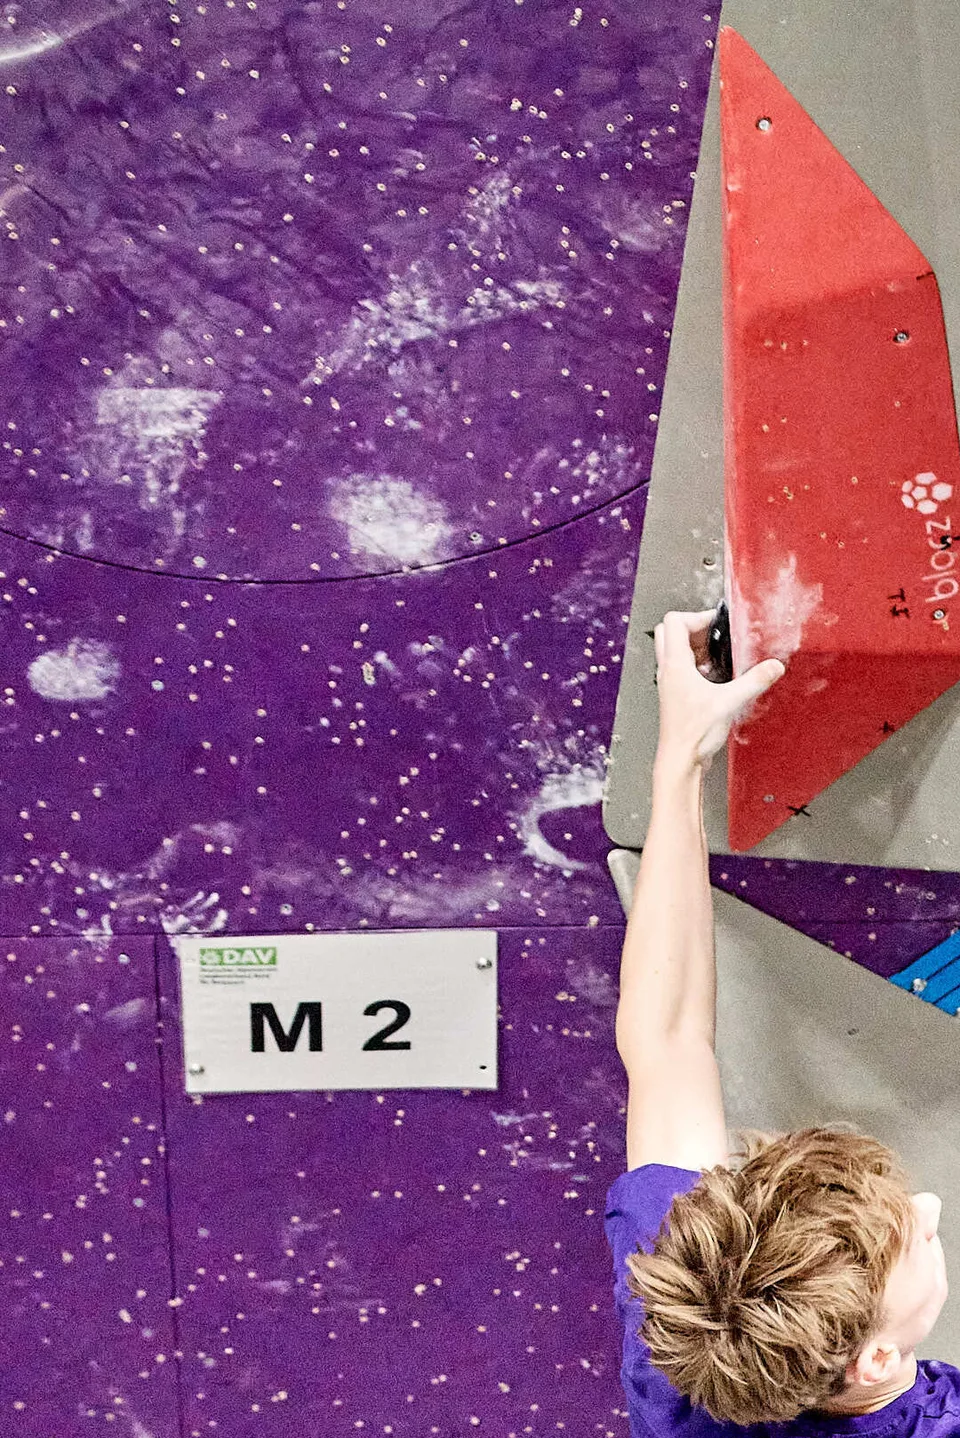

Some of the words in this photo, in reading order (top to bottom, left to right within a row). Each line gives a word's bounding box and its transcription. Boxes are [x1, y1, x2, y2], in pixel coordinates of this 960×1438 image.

[222, 949, 273, 965] DAV
[250, 1002, 323, 1053] M
[362, 999, 411, 1052] 2
